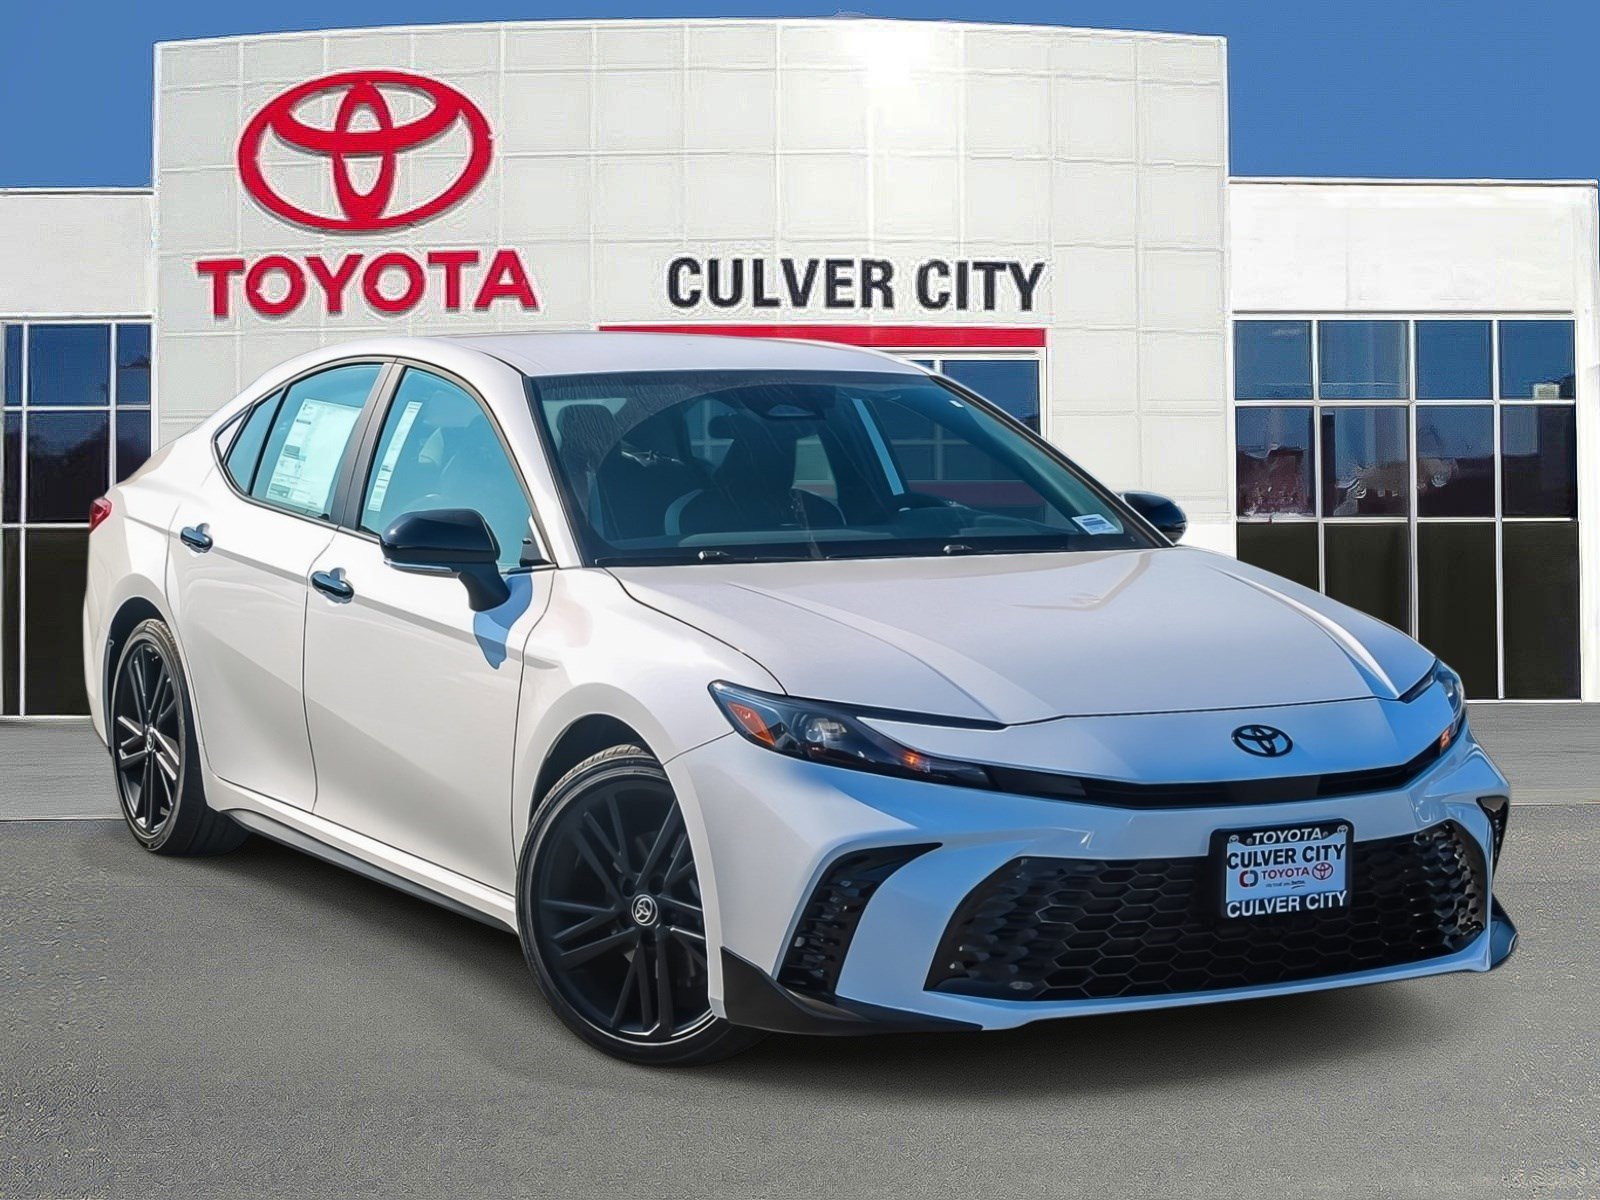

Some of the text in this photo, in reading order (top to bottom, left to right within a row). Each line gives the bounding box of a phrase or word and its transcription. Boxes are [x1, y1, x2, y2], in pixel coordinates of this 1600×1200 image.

[195, 249, 539, 319] TOYOTA
[667, 257, 1046, 312] CULVER CITY
[1252, 827, 1322, 845] TOYOTA
[1227, 843, 1346, 870] CULVER CITY
[1261, 867, 1310, 880] TOYOTA
[1227, 890, 1347, 918] CULVER CITY
